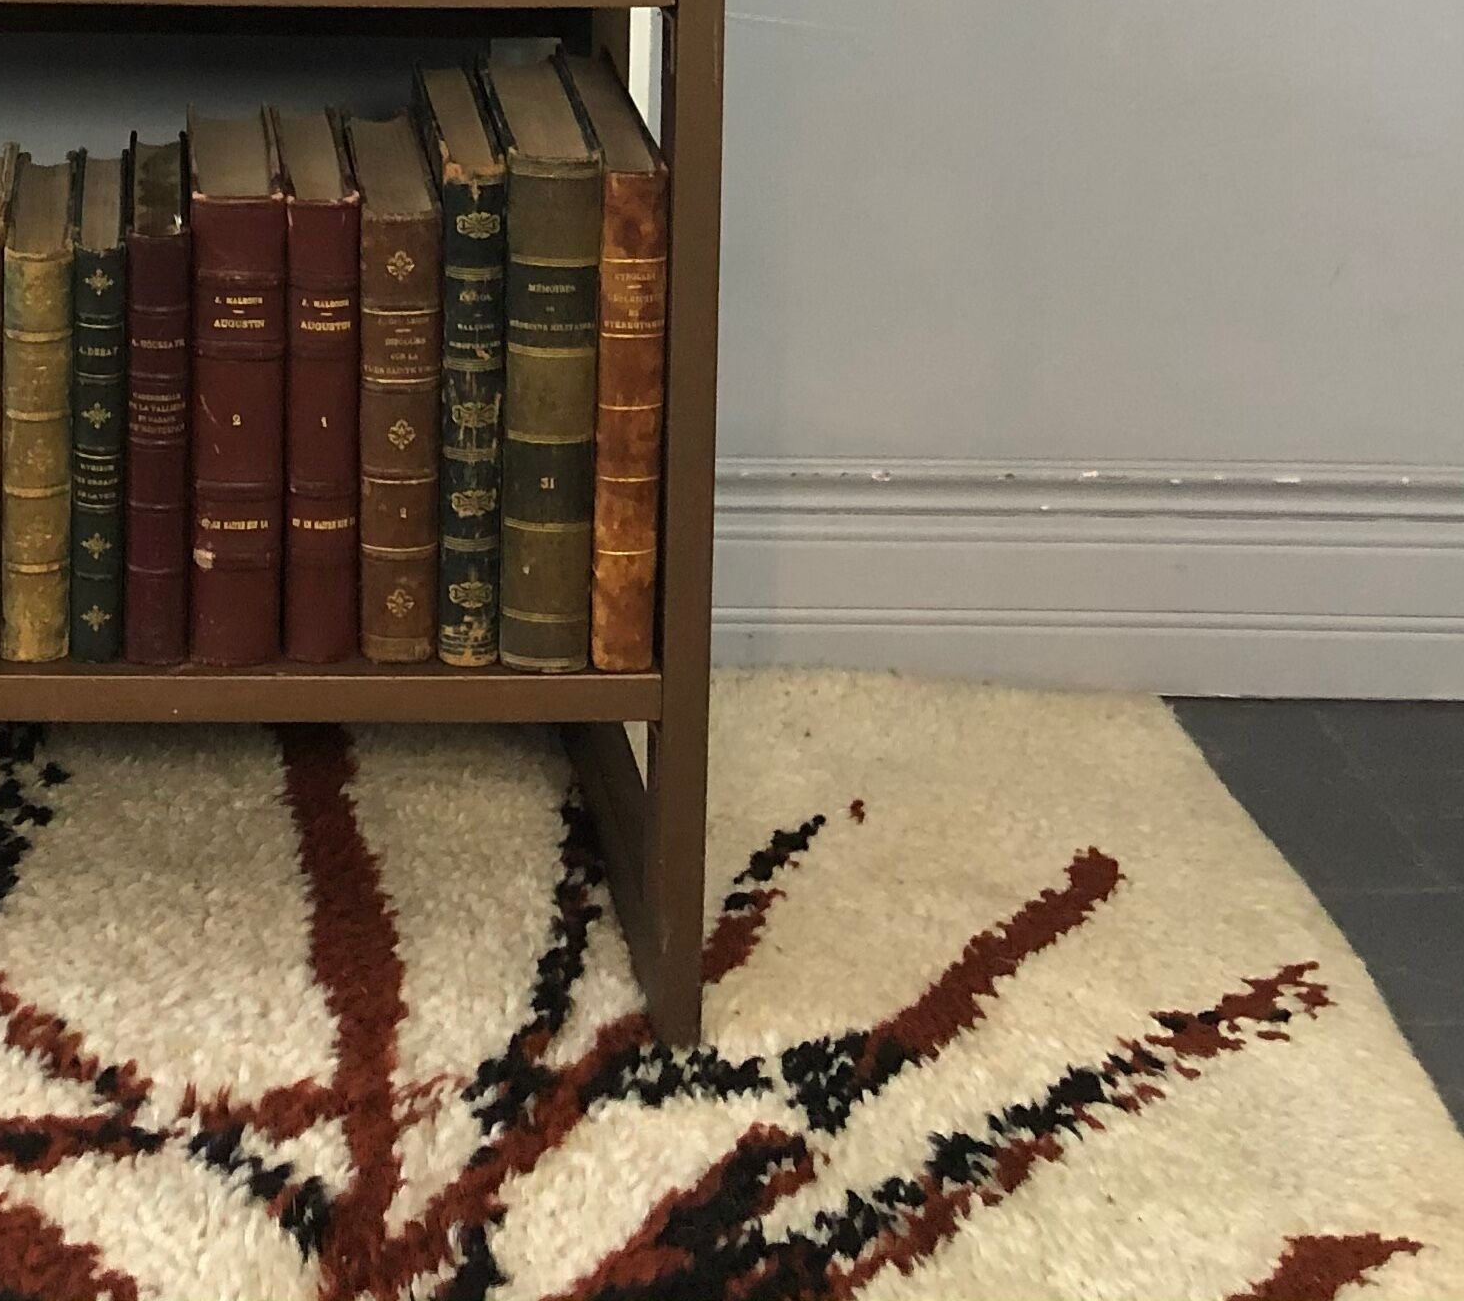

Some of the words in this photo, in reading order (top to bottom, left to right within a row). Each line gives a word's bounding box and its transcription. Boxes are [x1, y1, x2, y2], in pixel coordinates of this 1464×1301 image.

[213, 319, 265, 329] AUGUSTIN
[300, 320, 351, 331] AUGUSTIN
[232, 414, 242, 426] 2
